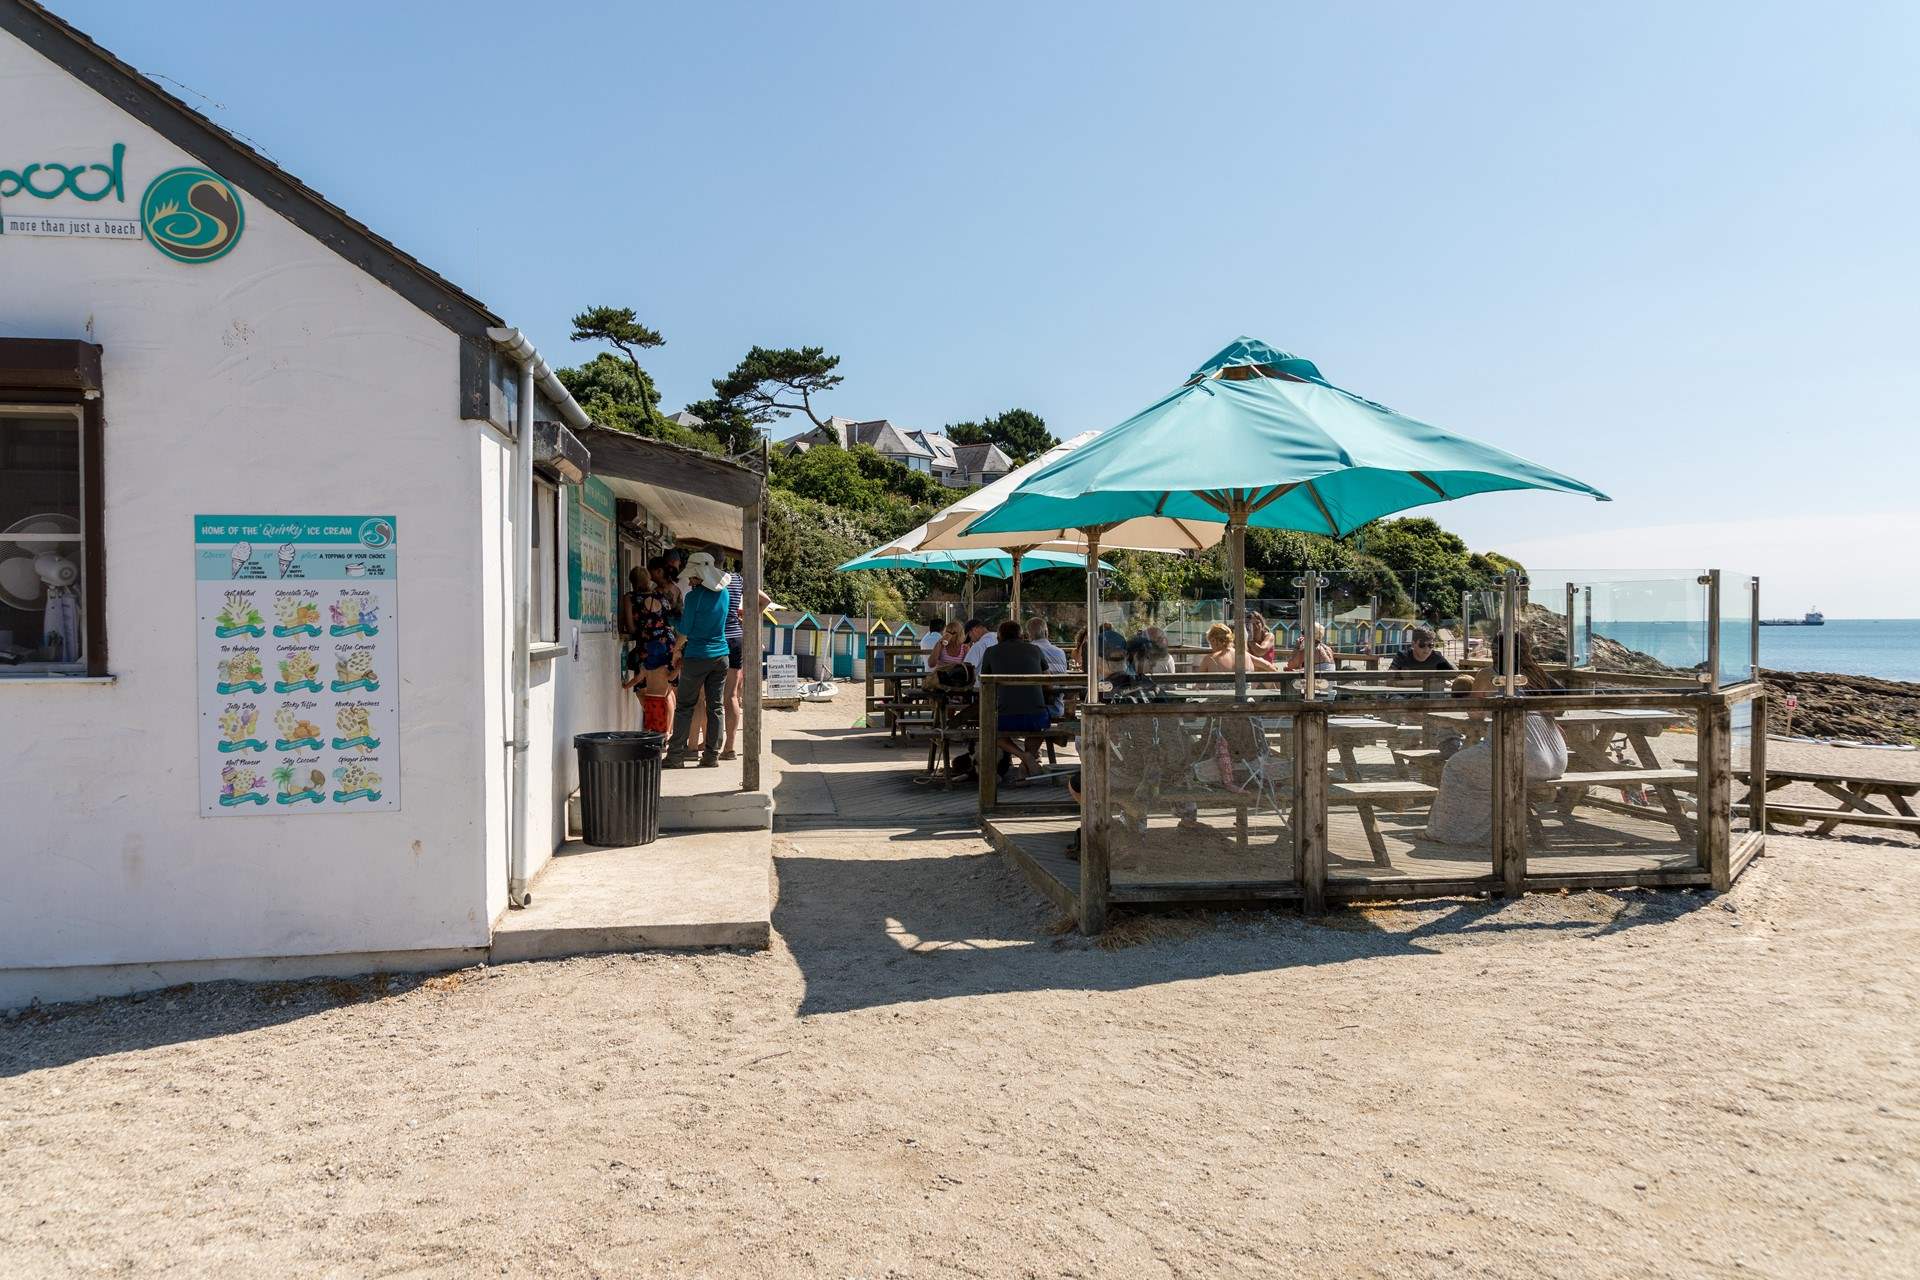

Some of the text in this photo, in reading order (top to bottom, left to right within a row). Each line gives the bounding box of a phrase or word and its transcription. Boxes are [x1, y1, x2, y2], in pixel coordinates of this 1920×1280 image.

[10, 219, 136, 235] more than just a beach
[201, 525, 225, 535] HOME
[228, 525, 239, 535] OF
[242, 525, 258, 535] THE
[307, 526, 321, 536] ICE
[323, 526, 352, 536] CREAM
[275, 589, 302, 597] Chocolate
[220, 644, 260, 654] The Hedgehog
[276, 644, 306, 652] Caribbean
[334, 643, 376, 652] Coffee Crunch
[226, 702, 257, 711] Jelly Belly
[281, 700, 317, 710] Sticky Toffee
[334, 700, 355, 709] Monkey
[296, 756, 320, 764] Coconut
[337, 756, 359, 765] Ginger
